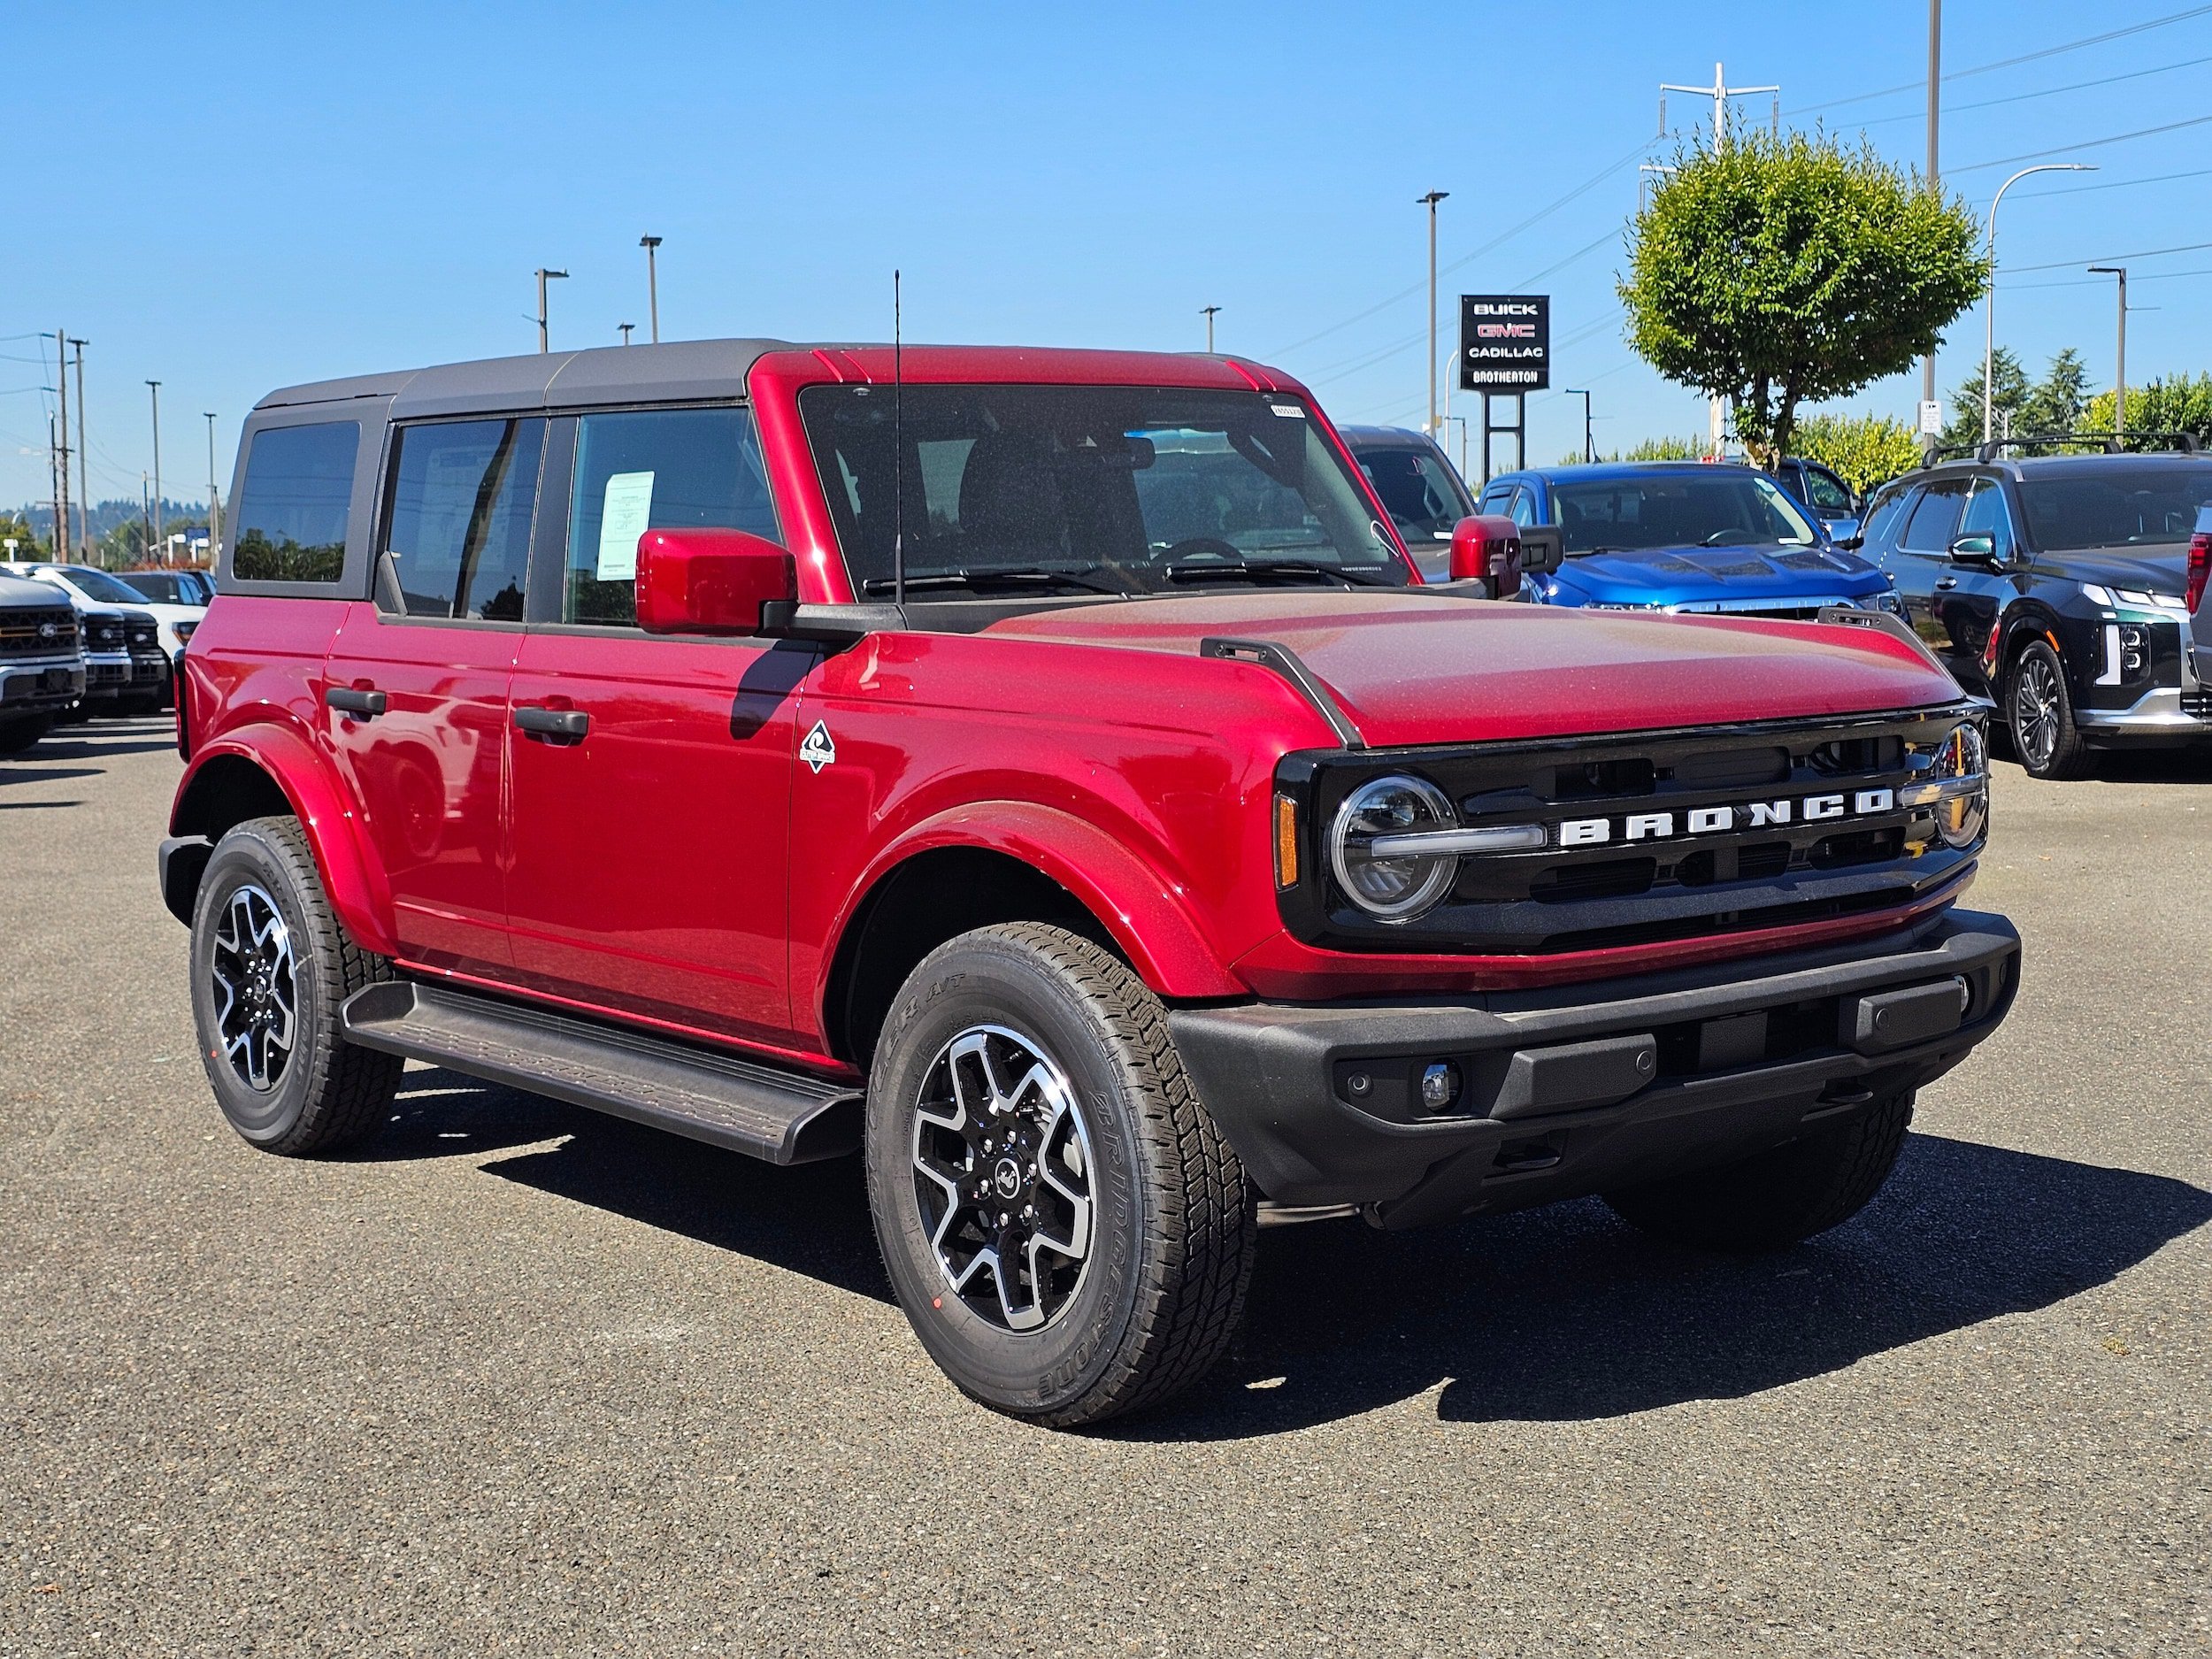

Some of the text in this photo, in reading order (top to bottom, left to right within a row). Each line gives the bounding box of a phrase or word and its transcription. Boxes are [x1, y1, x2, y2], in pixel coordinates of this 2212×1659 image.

[1473, 303, 1539, 316] BUICK
[1477, 323, 1536, 338] GMC
[1469, 347, 1544, 358] CADILLAC
[1473, 371, 1538, 383] BROTHERTON
[1559, 789, 1893, 847] BRONCO
[926, 972, 966, 1003] A/T
[1038, 1090, 1130, 1399] BRIDGESTONE
